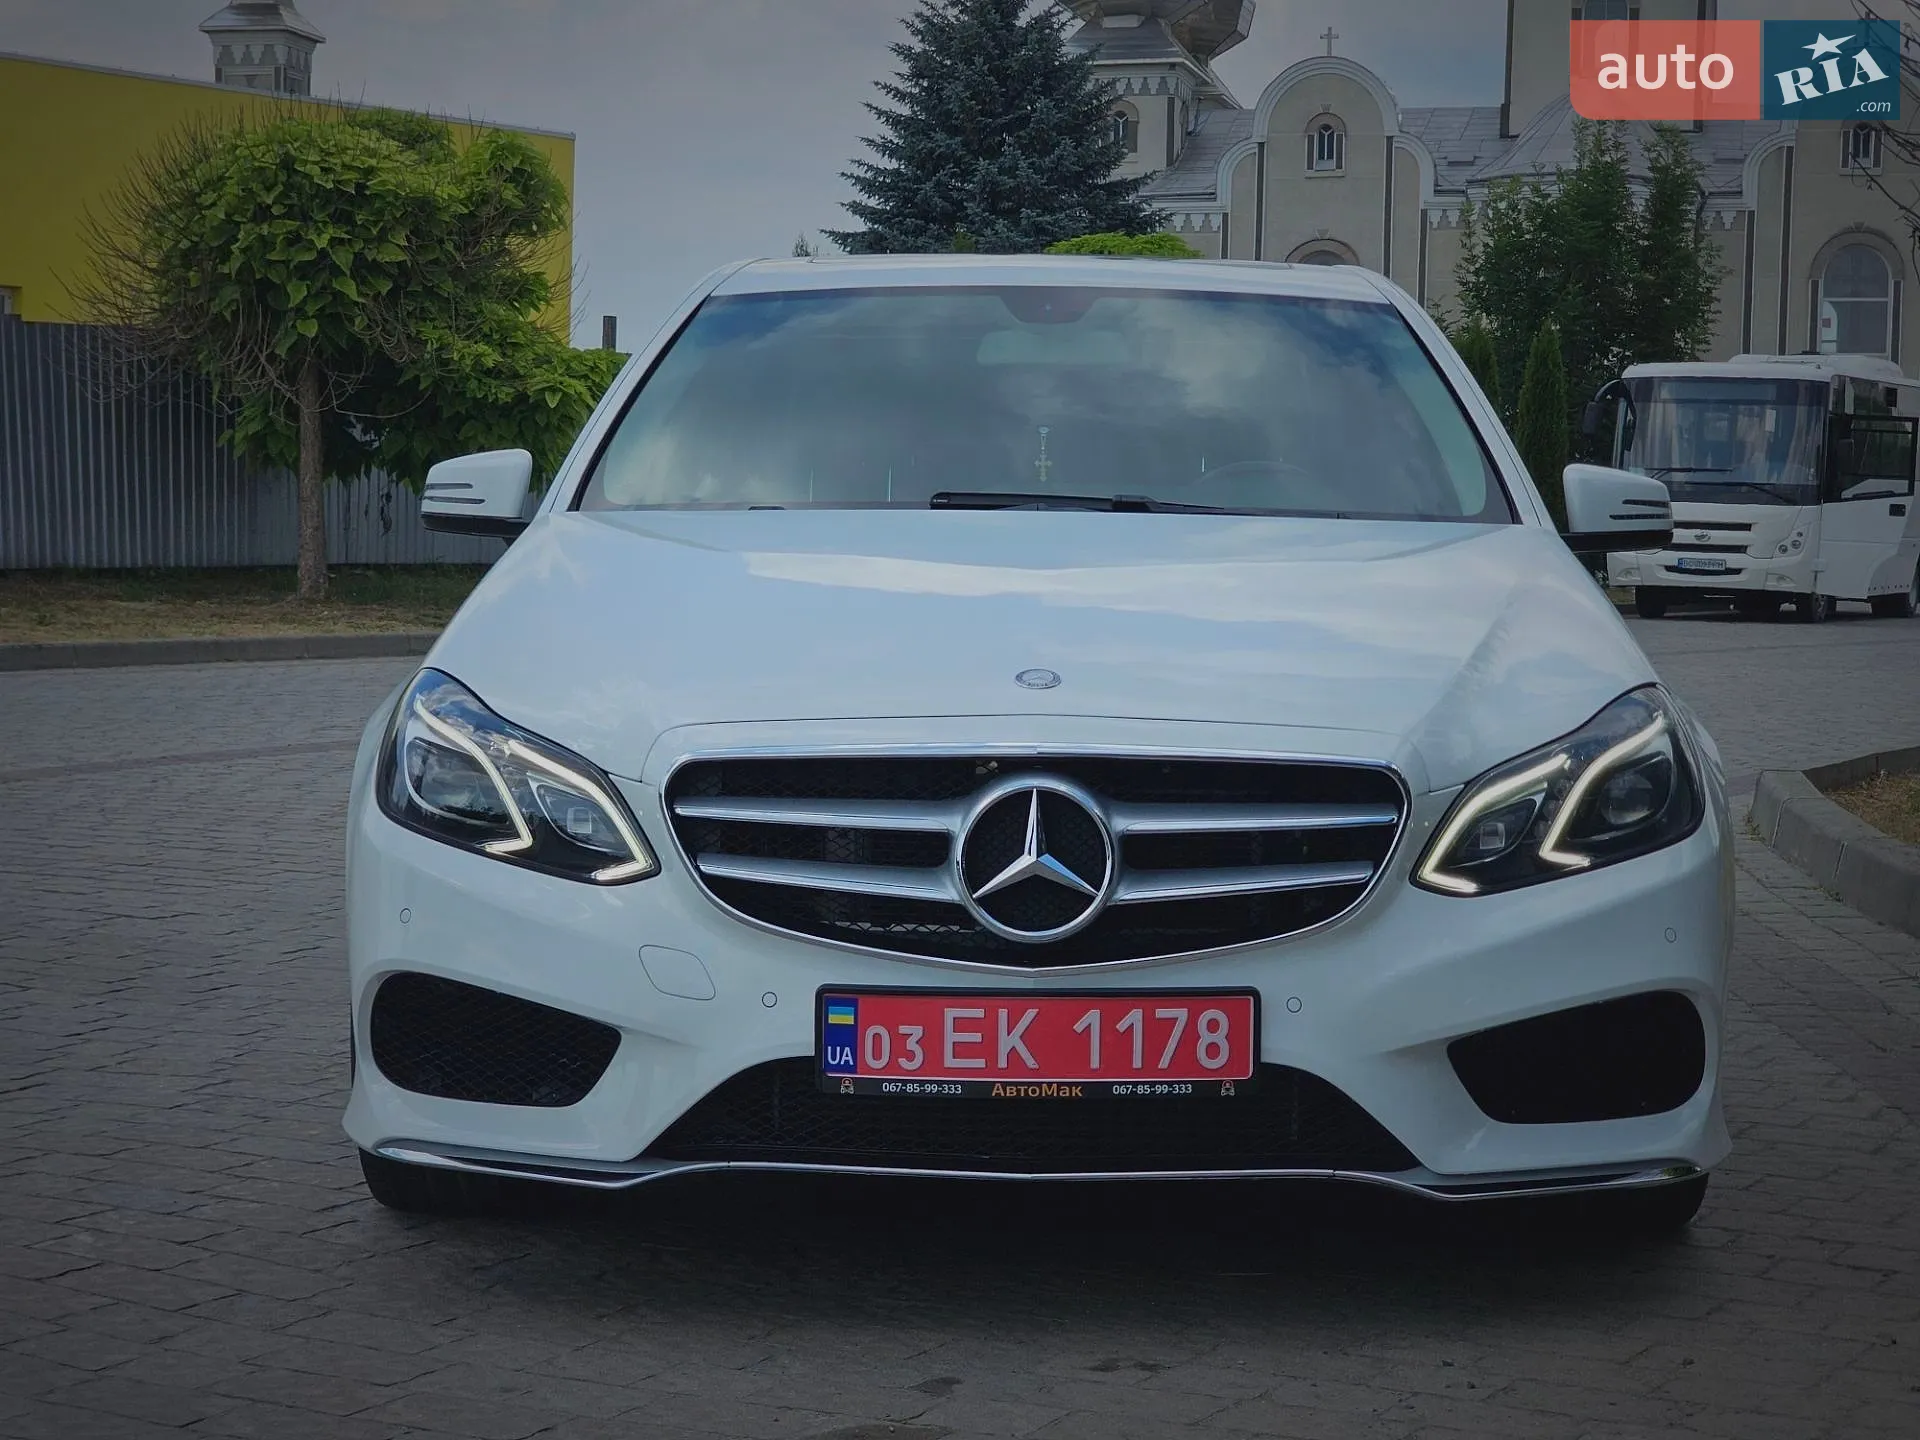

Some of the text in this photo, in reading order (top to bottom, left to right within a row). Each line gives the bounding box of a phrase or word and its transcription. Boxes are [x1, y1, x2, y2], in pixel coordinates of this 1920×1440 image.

[864, 1007, 1230, 1070] 03 EK 1178
[827, 1046, 854, 1066] UA
[881, 1082, 963, 1095] 067-85-99-333
[991, 1083, 1083, 1098] АвтоМак
[1112, 1083, 1193, 1096] 067-85-99-333
